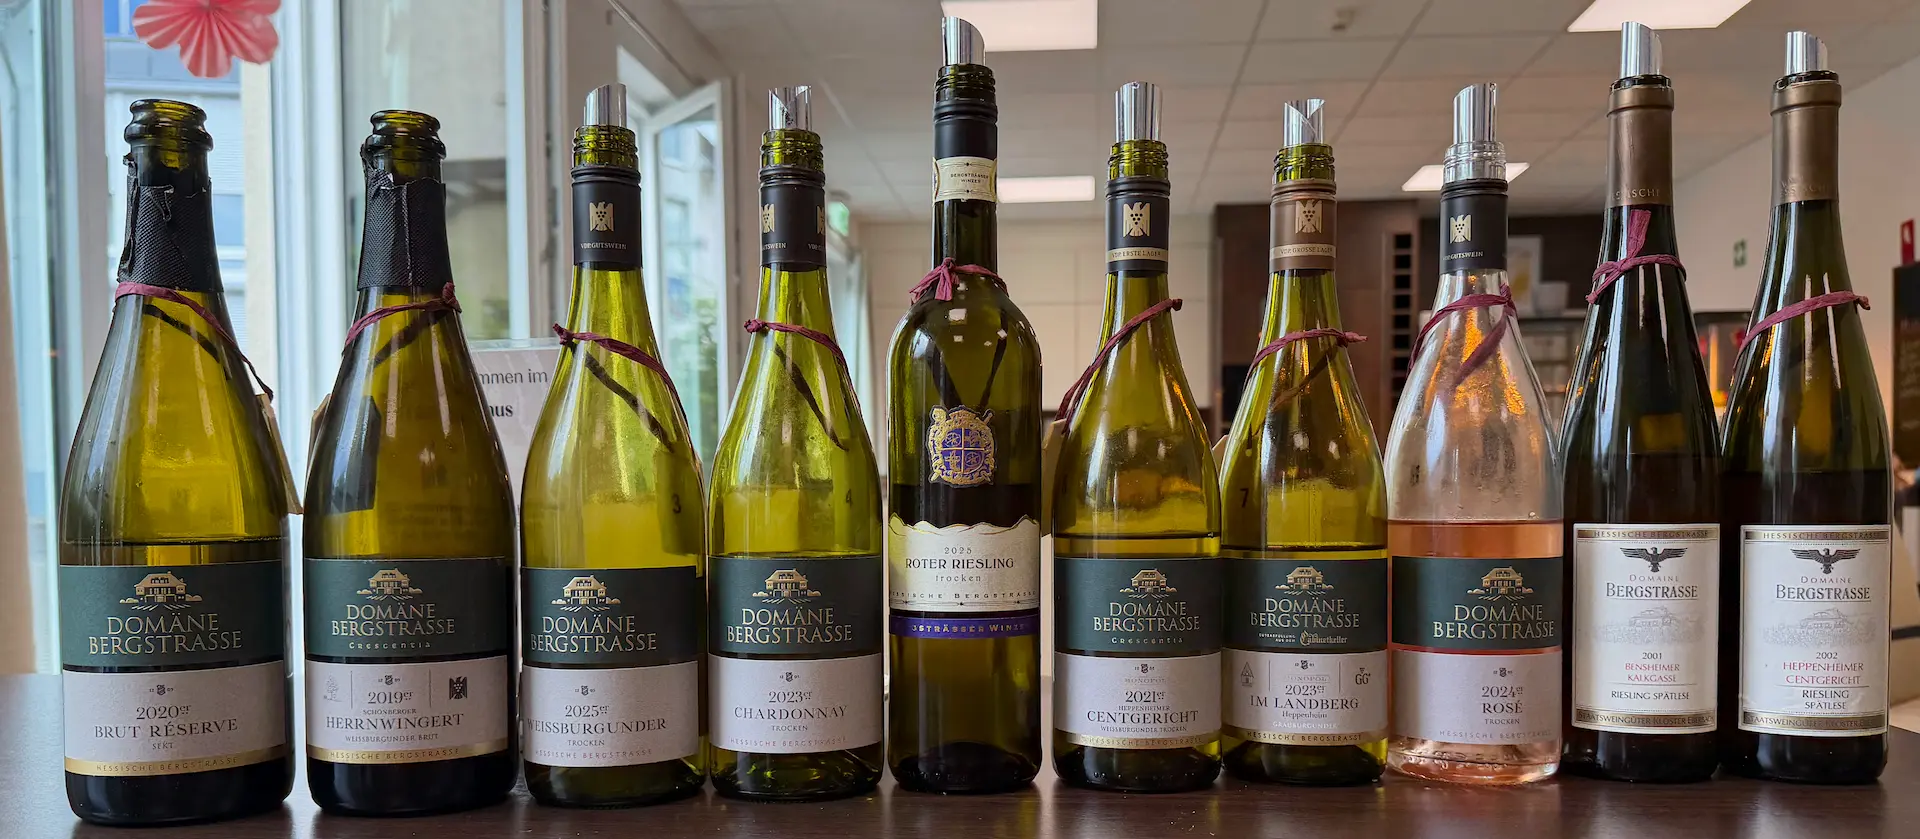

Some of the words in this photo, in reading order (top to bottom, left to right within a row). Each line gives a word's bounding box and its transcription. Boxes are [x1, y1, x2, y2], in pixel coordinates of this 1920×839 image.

[478, 372, 523, 385] mmen
[528, 368, 548, 383] im
[1239, 487, 1250, 508] 7
[1594, 530, 1647, 538] HESSISCHE
[944, 547, 972, 555] 2025
[905, 558, 947, 570] ROTER
[952, 557, 1014, 570] RIESLING
[935, 574, 981, 582] trocken
[1606, 582, 1698, 598] BERGSTRASSE
[1776, 584, 1870, 600] BERGSTRASSE
[346, 601, 436, 621] DOMÄNE
[1109, 600, 1187, 617] DOMÄNE
[1265, 597, 1344, 613] DOMÄNE
[741, 606, 834, 626] DOMÄNE
[1454, 603, 1543, 622] DOMÄNE
[107, 612, 220, 635] DOMÄNE
[542, 614, 636, 634] DOMÄNE
[1093, 615, 1200, 632] BERGSTRASSE
[1250, 613, 1360, 628] BERGSTRASSE
[331, 619, 455, 637] BERGSTRASSE
[726, 624, 852, 644] BERGSTRASSE
[1433, 621, 1554, 640] BERGSTRASSE
[89, 630, 243, 656] BERGSTRASSE
[530, 633, 657, 653] BERGSTRASSE
[1642, 652, 1662, 660] 2001
[1816, 651, 1838, 660] 2002
[1625, 662, 1680, 672] BENSHEIMER
[1783, 662, 1864, 672] HEPPENHEIMER
[1627, 674, 1677, 683] KALKGASSE
[1786, 675, 1862, 685] CENTGERICHT
[1611, 690, 1651, 700] RIESLING
[1653, 689, 1690, 700] SPÄTLESE
[1802, 689, 1849, 699] RIESLING
[1250, 695, 1268, 708] IM
[1274, 698, 1359, 710] LANDBERG
[1482, 700, 1523, 714] ROSÉ
[1805, 701, 1847, 710] SPÄTLESE
[734, 705, 847, 720] CHARDONNAY
[1087, 710, 1199, 724] CENTGERICHT
[1282, 710, 1328, 720] Heppenheim
[326, 713, 464, 731] HERRNWINGERT
[527, 718, 667, 735] WEISSBURGUNDER
[771, 724, 808, 732] TROCKEN
[1652, 717, 1686, 725] KLOSTER
[94, 725, 140, 739] BRUT
[150, 718, 238, 738] RÉSERVE
[1439, 730, 1493, 739] HESSISCHE
[345, 734, 415, 743] WEISSBURGUNDER
[418, 733, 439, 742] BRUT
[567, 739, 605, 747] TROCKEN
[730, 738, 777, 747] HESSISCHE
[1247, 731, 1296, 741] HESSISCHE
[1301, 734, 1361, 742] BERGSTRASSE
[152, 741, 174, 750] SEKT
[330, 752, 380, 760] HESSISCHE
[386, 748, 459, 760] BERGSTRASSE
[582, 748, 653, 759] BERGSTRASSE
[96, 763, 152, 772] HESSISCHE
[160, 757, 238, 771] BERGSTRASSE
